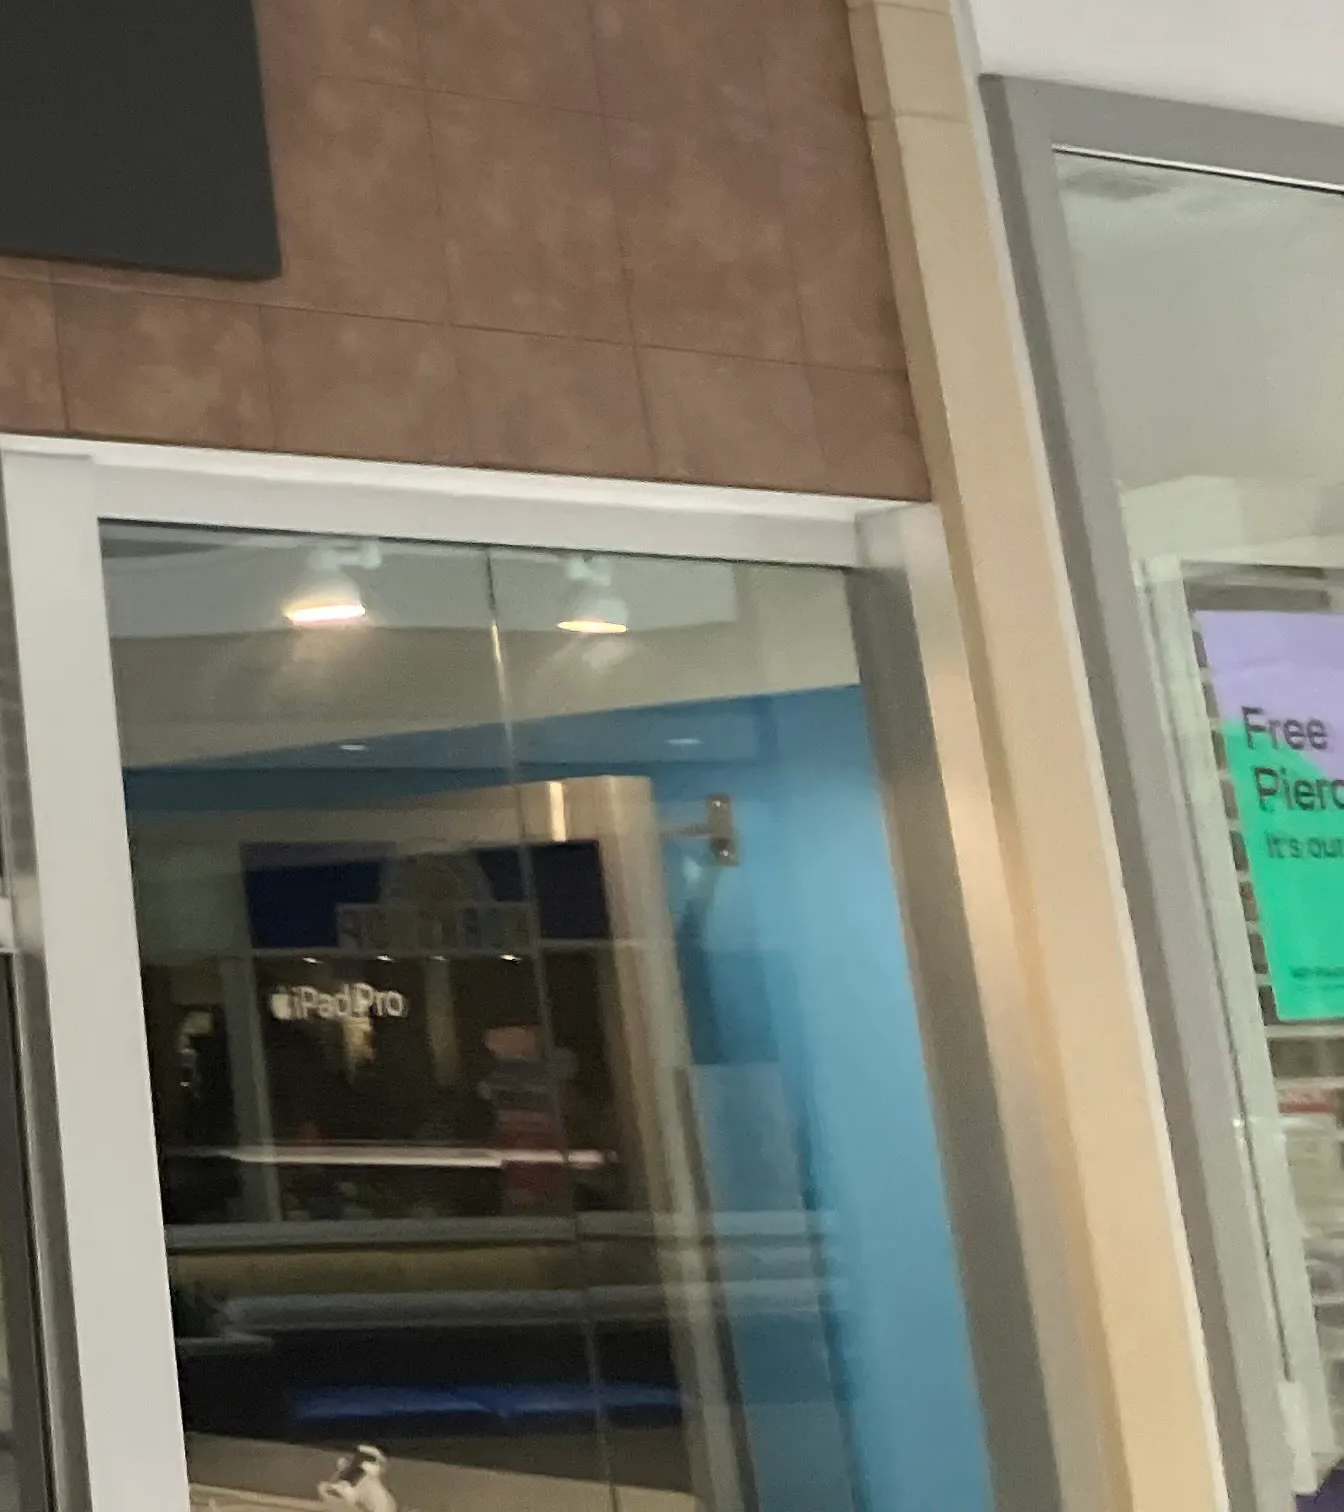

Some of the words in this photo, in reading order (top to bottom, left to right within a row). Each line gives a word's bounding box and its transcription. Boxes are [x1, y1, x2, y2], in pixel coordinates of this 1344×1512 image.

[1242, 706, 1329, 750] Free
[1254, 766, 1344, 812] Pierc
[292, 984, 351, 1019] iPad
[352, 983, 406, 1018] Pro
